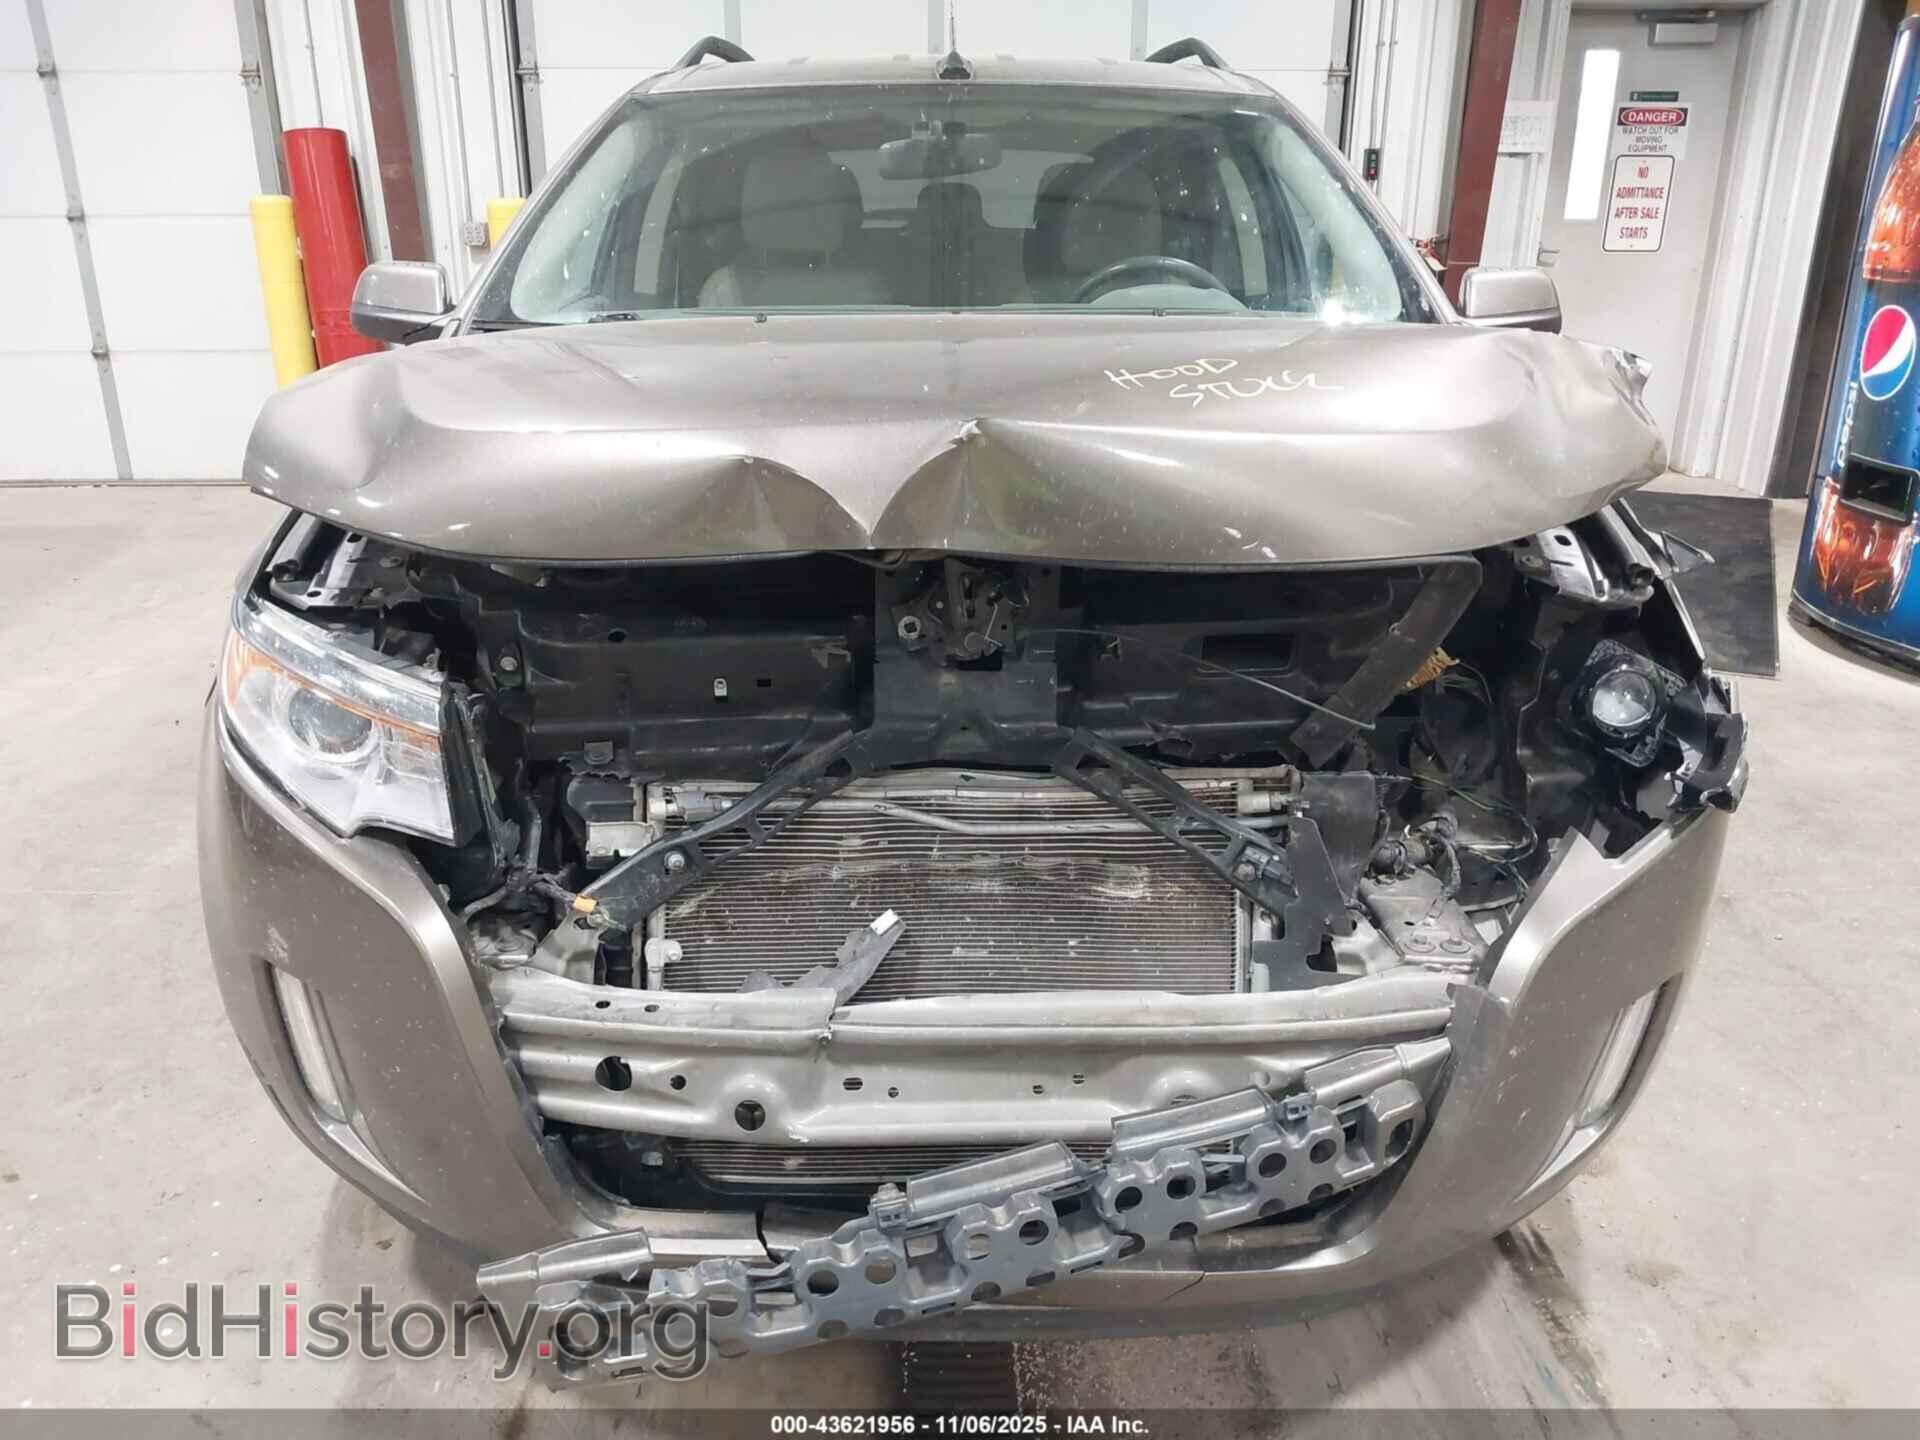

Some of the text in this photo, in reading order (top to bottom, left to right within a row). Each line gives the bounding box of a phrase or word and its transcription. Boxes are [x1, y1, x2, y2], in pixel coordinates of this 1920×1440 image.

[1628, 111, 1677, 122] DANGER
[1622, 126, 1679, 135] WATCH OUT FOR
[1635, 135, 1663, 144] MOVING
[1627, 144, 1668, 153] EQUIPMENT
[1637, 166, 1649, 178] NO
[1616, 186, 1664, 199] ADMITTANCE
[1615, 207, 1660, 219] AFTER SALE
[1619, 226, 1648, 239] STARTS
[1103, 357, 1239, 390] HOOD
[1837, 381, 1859, 469] pepsi
